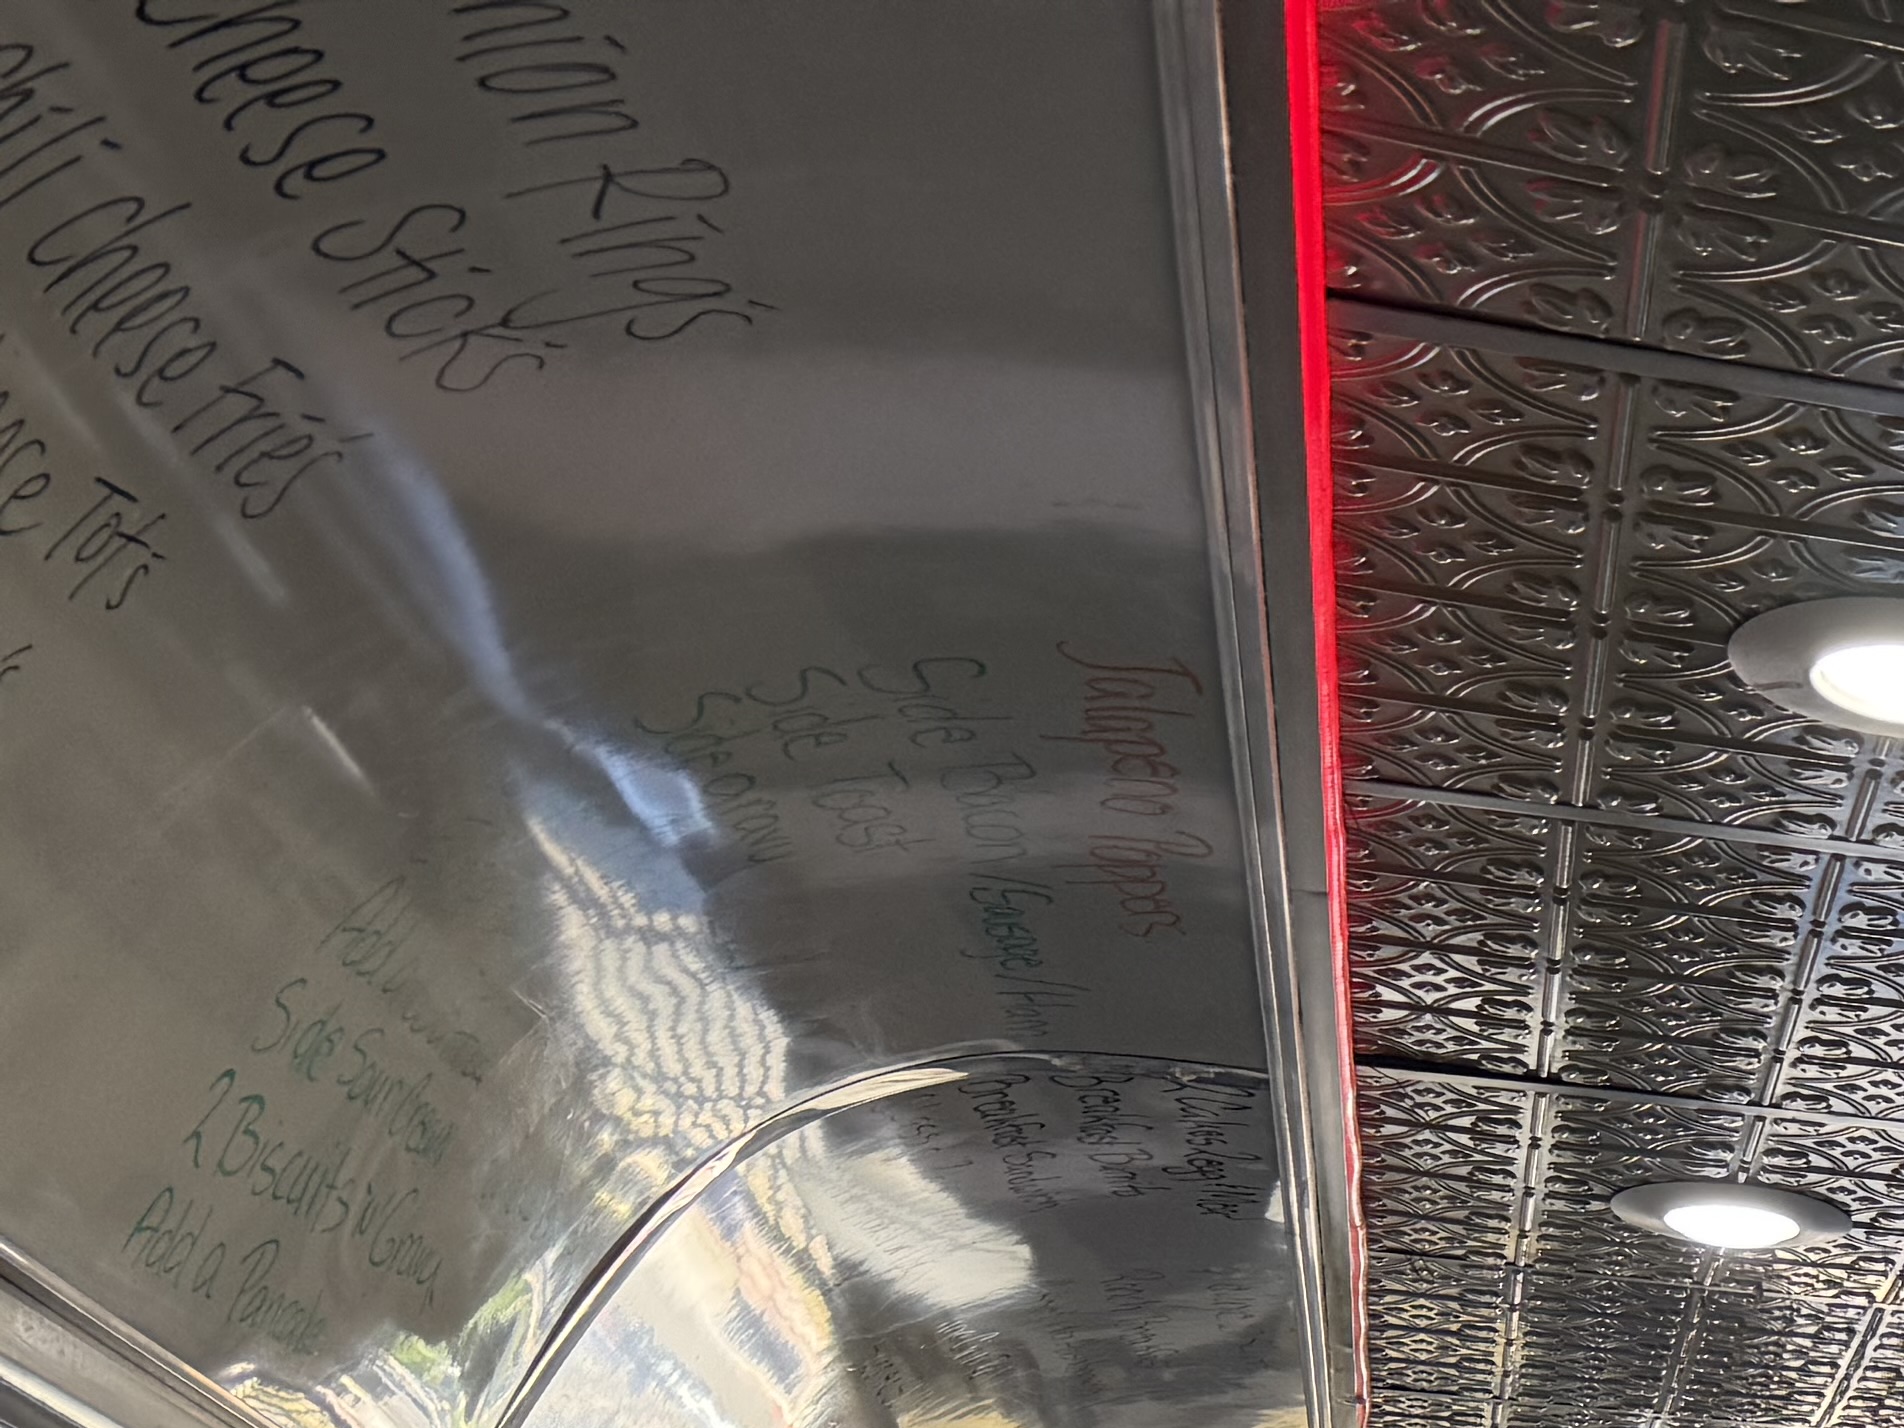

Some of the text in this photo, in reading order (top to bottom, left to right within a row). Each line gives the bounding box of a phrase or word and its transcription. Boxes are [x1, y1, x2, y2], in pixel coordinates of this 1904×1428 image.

[311, 203, 568, 392] Sticks
[502, 157, 782, 341] Rings
[28, 196, 218, 406] Cheese
[171, 357, 375, 520] Fries
[45, 477, 167, 610] Tots
